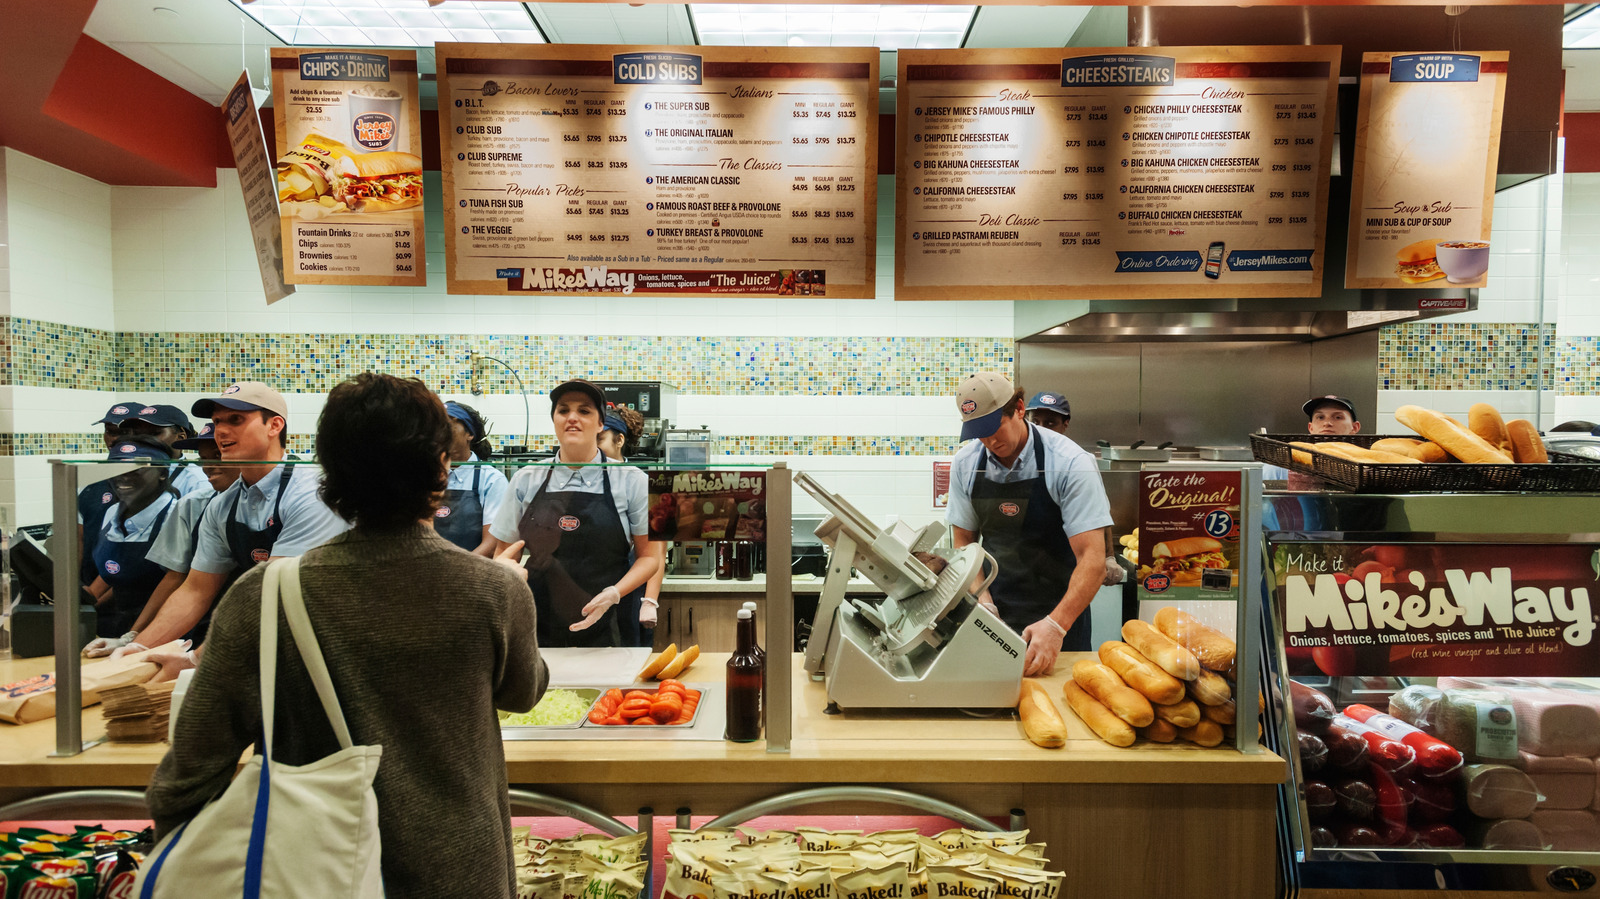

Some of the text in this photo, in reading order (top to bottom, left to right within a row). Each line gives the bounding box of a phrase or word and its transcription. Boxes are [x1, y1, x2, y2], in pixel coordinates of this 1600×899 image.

[303, 62, 339, 76] CHIPS
[347, 61, 386, 78] DRINK
[618, 62, 698, 81] COLD SUBS
[1415, 63, 1454, 79] SOUP
[1066, 65, 1170, 85] CHEESESTEAKS
[505, 82, 579, 96] Bacon Lovers
[730, 84, 774, 99] Italians
[1201, 87, 1245, 99] Chicken
[999, 88, 1031, 102] Steak
[465, 99, 484, 108] B.L.T.
[655, 102, 709, 111] THE SUPER SUB
[925, 107, 1035, 115] JERSEY MIKE'S FAMOUS PHILLY
[1134, 105, 1242, 114] CHICKEN PHILLY CHEESESTEAK
[356, 119, 392, 131] Jersey
[467, 126, 502, 134] CLUB SUB
[655, 129, 733, 138] THE ORIGINAL ITALIAN
[925, 134, 1009, 142] CHIPOTLE CHEESESTEAK
[1132, 131, 1250, 141] CHICKEN CHIPOTLE CHEESESTEAK
[468, 152, 522, 161] CLUB SUPREME
[719, 157, 782, 171] The Classics
[970, 160, 1019, 168] CHEESESTEAK
[1131, 157, 1260, 167] BIG KAHUNA CHICKEN CHEESESTEAK
[656, 176, 740, 185] THE AMERICAN CLASSIC
[506, 182, 585, 198] Popular Picks
[923, 187, 1016, 195] CALIFORNIA CHEESESTEAK
[1129, 184, 1254, 193] CALIFORNIA CHICKEN CHEESESTEAK
[469, 199, 523, 208] TUNA FISH SUB
[656, 202, 686, 211] FAMOUS
[688, 203, 711, 211] ROAST
[713, 203, 730, 211] BEEF
[739, 203, 781, 211] PROVOLONE
[1394, 201, 1420, 216] Soup
[1431, 201, 1452, 213] Sub
[979, 214, 1040, 226] Deli Classic
[1128, 211, 1242, 220] BUFFALO CHICKEN CHEESESTEAK
[1366, 218, 1451, 226] MINI SUB & CUP OF SOUP
[298, 228, 351, 237] Fountain Drinks
[472, 226, 512, 234] THE VEGGIE
[657, 229, 763, 238] TURKEY BREAST & PROVOLONE
[923, 231, 1019, 240] GRILLED PASTRAMI REUBEN
[299, 239, 318, 249] Chips
[299, 251, 332, 259] Brownies
[300, 263, 327, 271] Cookies
[1121, 256, 1153, 269] Online
[1155, 255, 1199, 270] Ordering
[1233, 255, 1307, 267] JerseyMikes.com
[638, 274, 661, 282] Onions,
[678, 280, 696, 288] spices
[1144, 473, 1206, 488] Taste the
[1149, 486, 1235, 511] Original!
[1208, 513, 1229, 535] 13
[1286, 553, 1344, 573] Make it
[973, 617, 1019, 659] BIZERBA
[1290, 635, 1331, 648] Onions,
[1334, 633, 1376, 646] lettuce,
[1378, 631, 1433, 645] tomatoes,
[1436, 630, 1471, 643] spices
[1474, 628, 1493, 640] and
[1411, 650, 1429, 659] (red
[1432, 650, 1451, 658] wine
[1454, 648, 1482, 662] vinegar
[1486, 646, 1501, 656] and
[1503, 646, 1522, 656] olive
[1524, 645, 1535, 655] oil
[937, 881, 995, 898] Baked!
